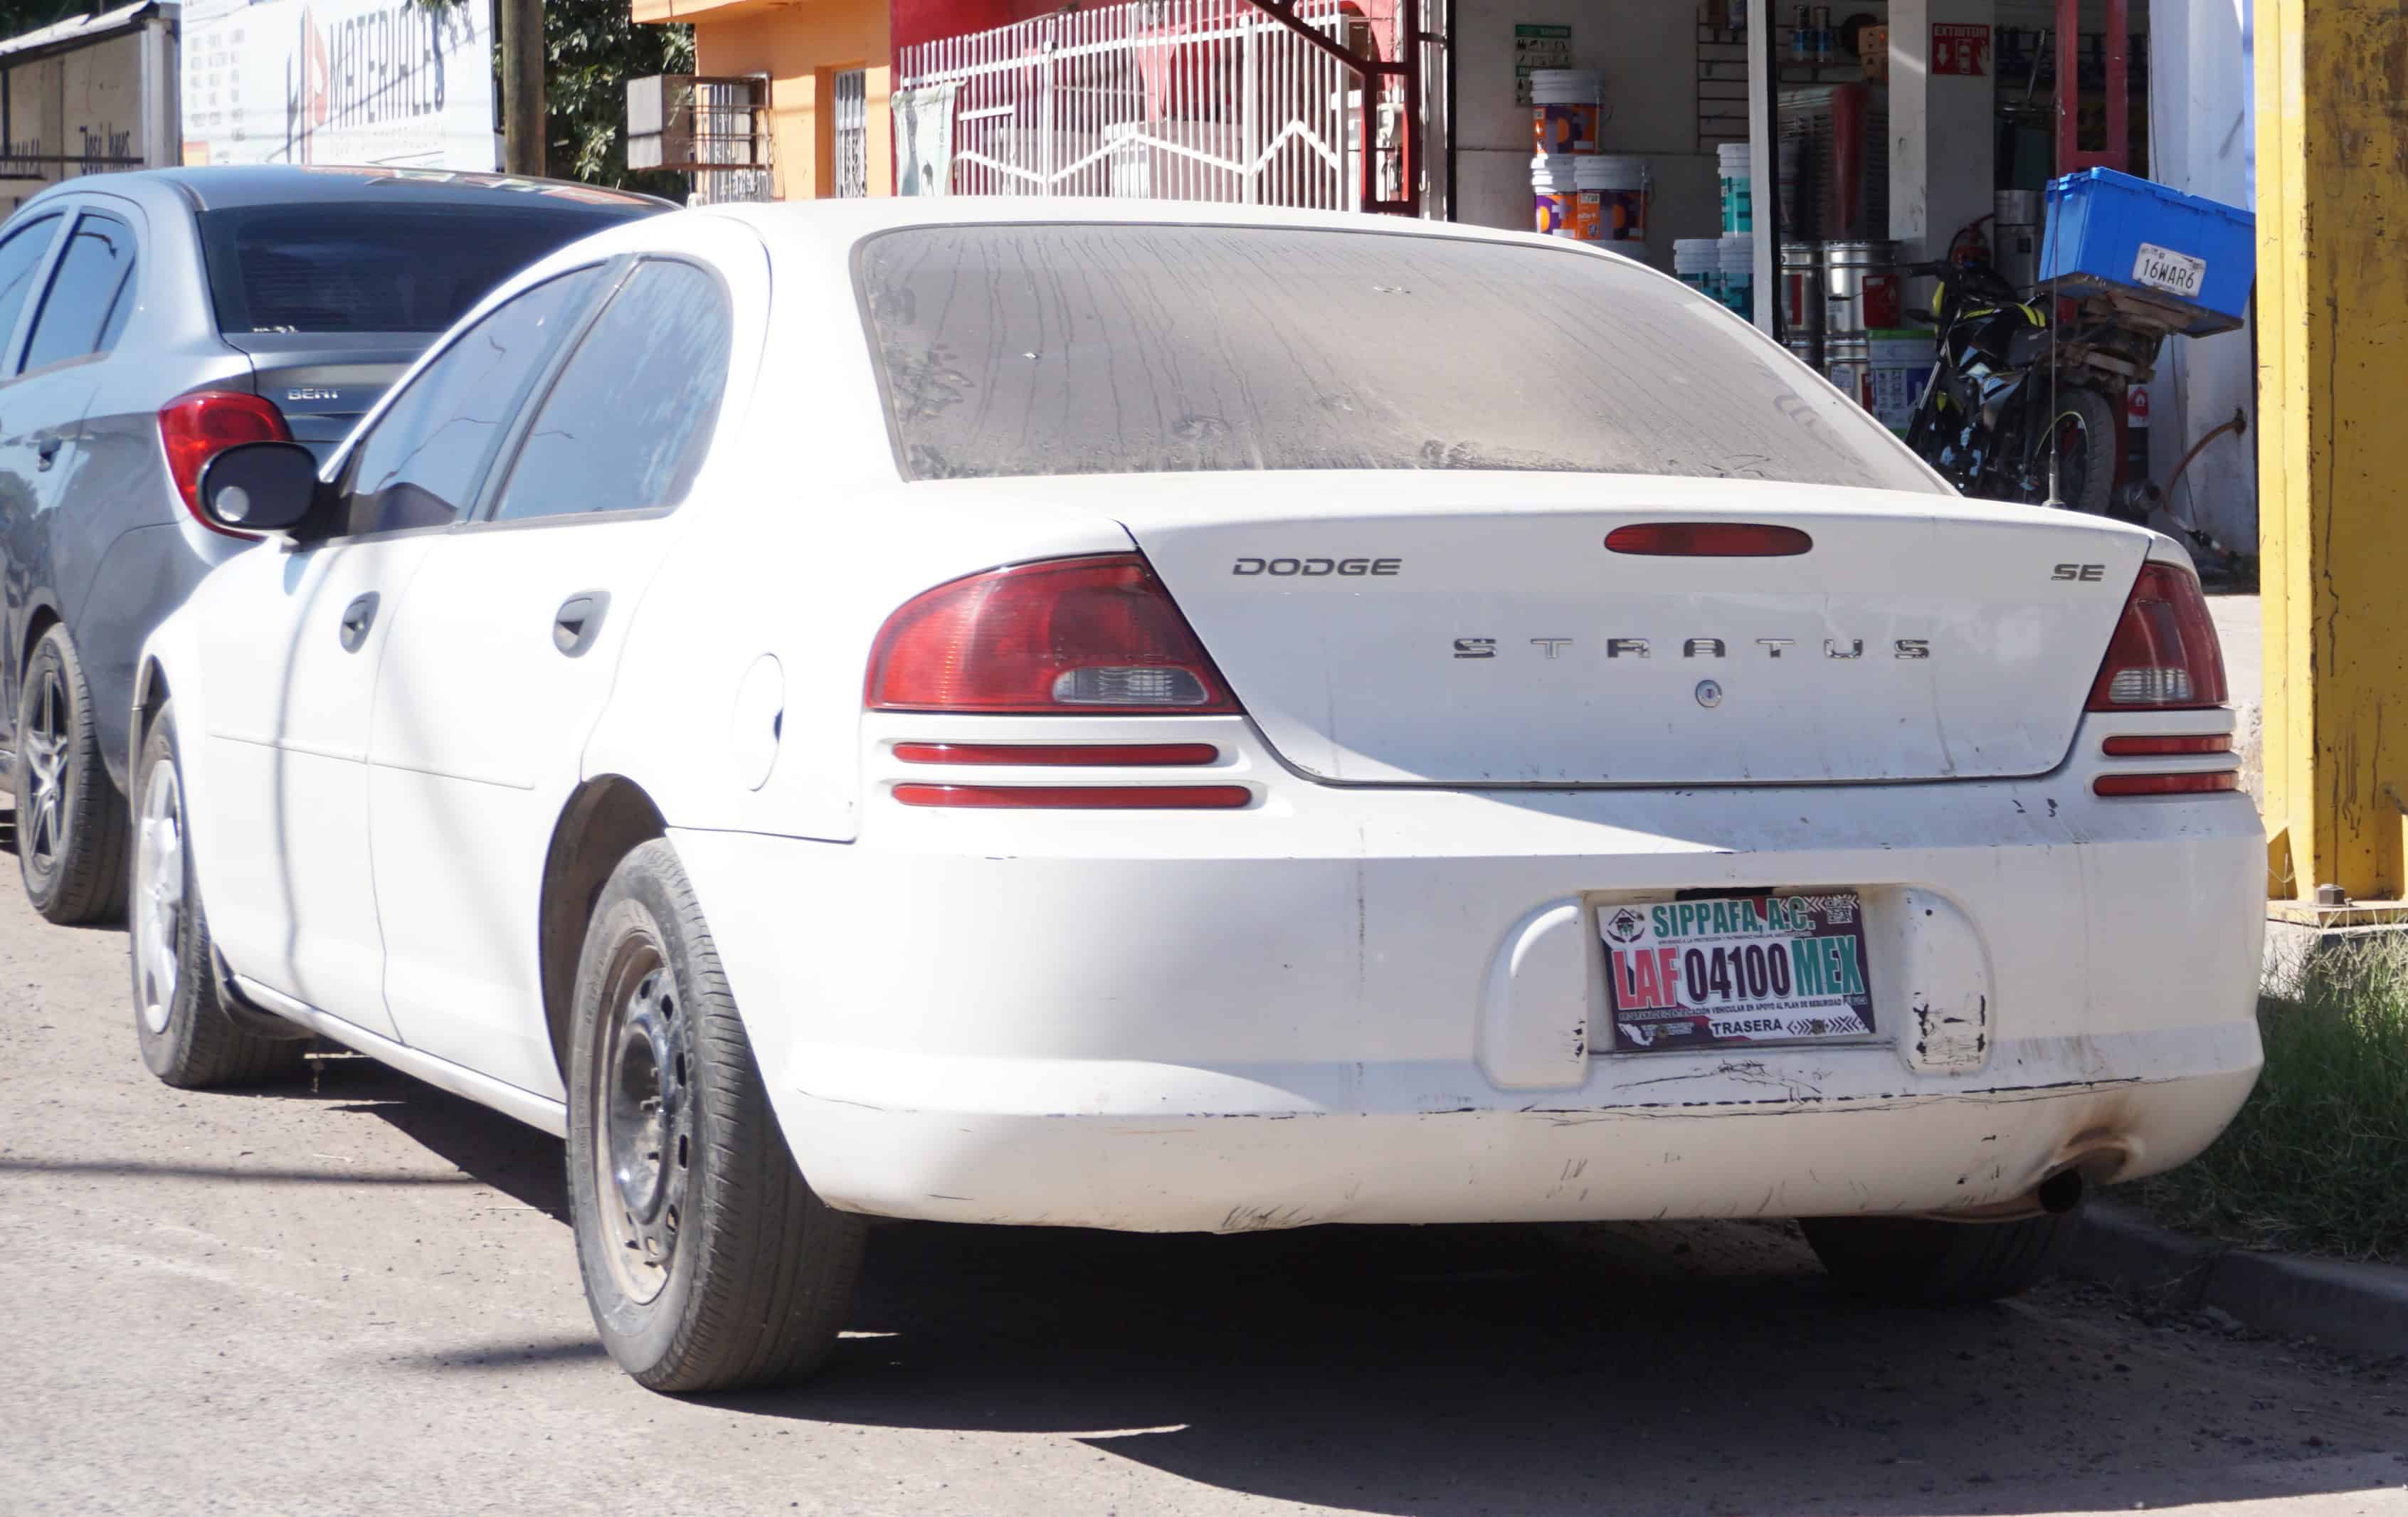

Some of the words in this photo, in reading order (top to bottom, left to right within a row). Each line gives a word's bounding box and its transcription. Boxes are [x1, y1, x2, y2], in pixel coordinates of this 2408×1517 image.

[329, 4, 445, 132] MATERIALES
[2143, 258, 2196, 289] 16WAR6
[1232, 557, 1403, 576] DODGE
[2050, 563, 2106, 582] SE
[1453, 638, 1930, 660] STRATUS
[1651, 899, 1763, 939] SIPPAFA,
[1768, 897, 1817, 932] A.C.
[1612, 946, 1680, 1010] LAF
[1684, 943, 1790, 1001] 04100
[1790, 935, 1866, 997] MEX
[1711, 1019, 1783, 1035] TRASERA
